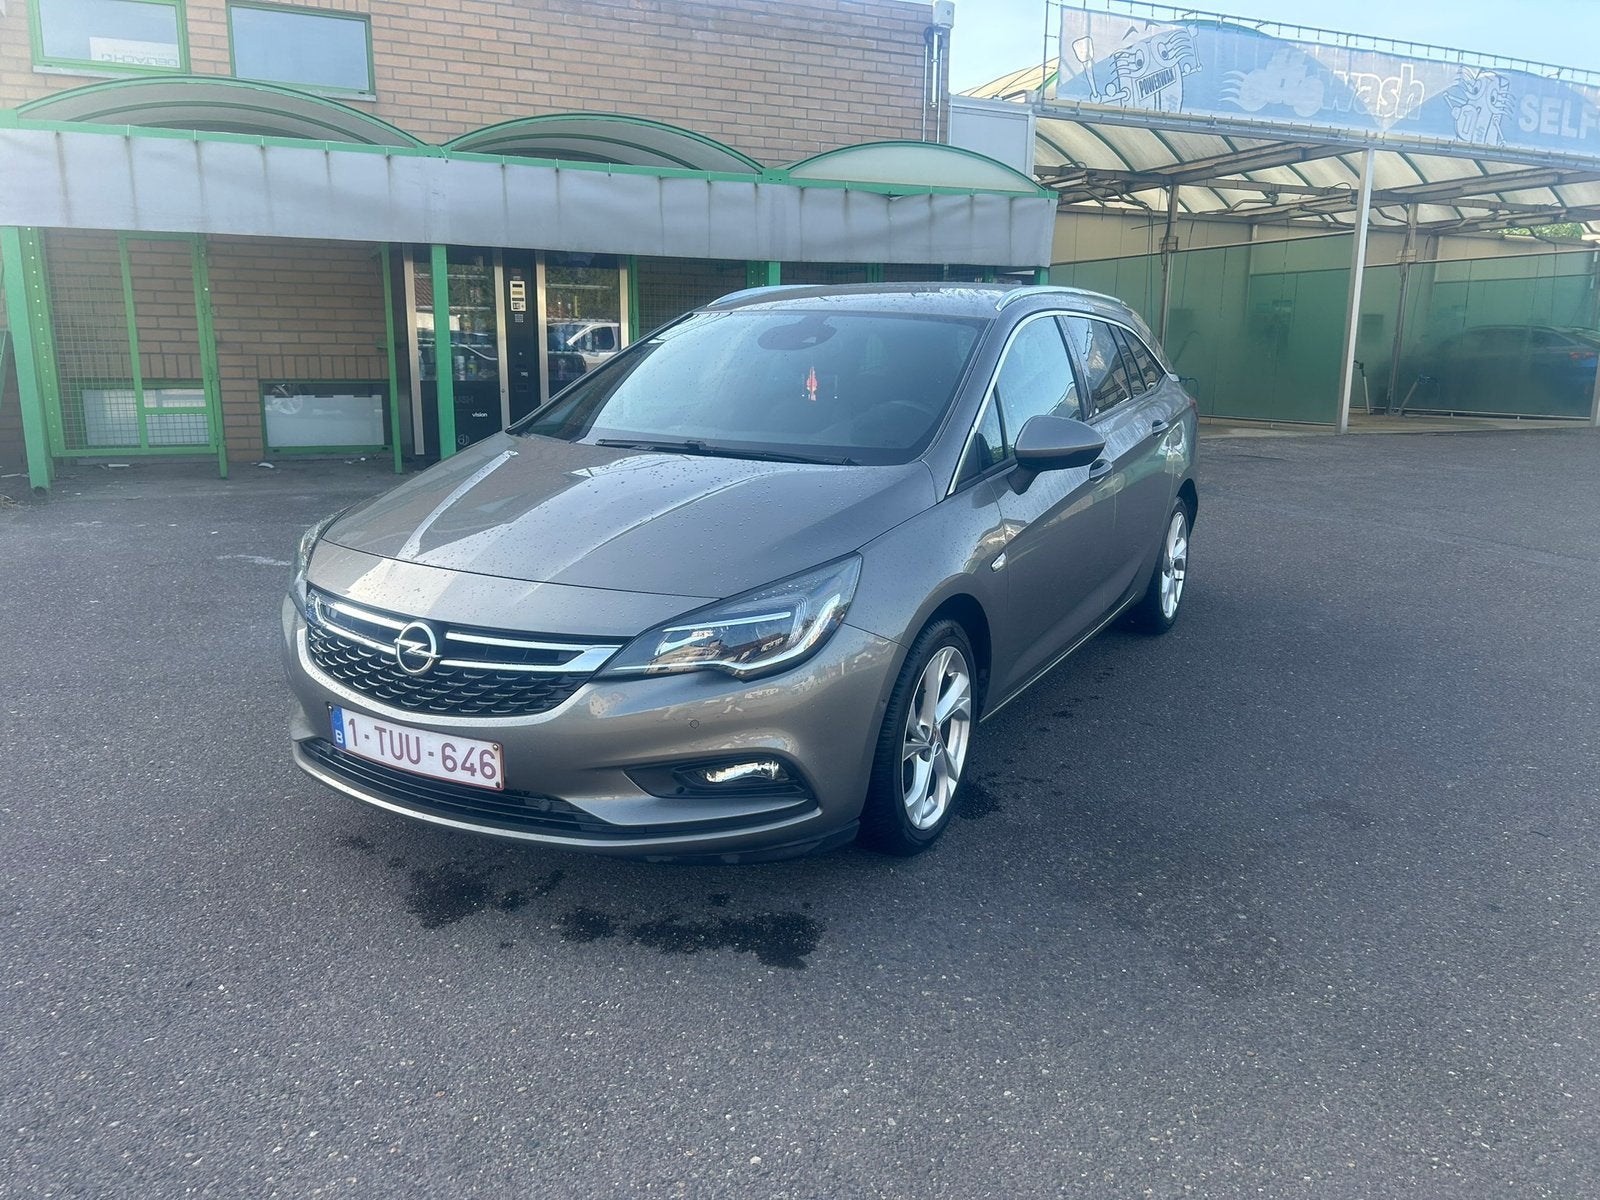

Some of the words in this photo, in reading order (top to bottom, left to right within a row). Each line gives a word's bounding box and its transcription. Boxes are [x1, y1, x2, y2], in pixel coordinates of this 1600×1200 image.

[1138, 67, 1175, 98] POWERWAX
[1318, 63, 1425, 120] wash
[335, 729, 344, 743] B
[348, 718, 497, 779] 1-TUU-646
